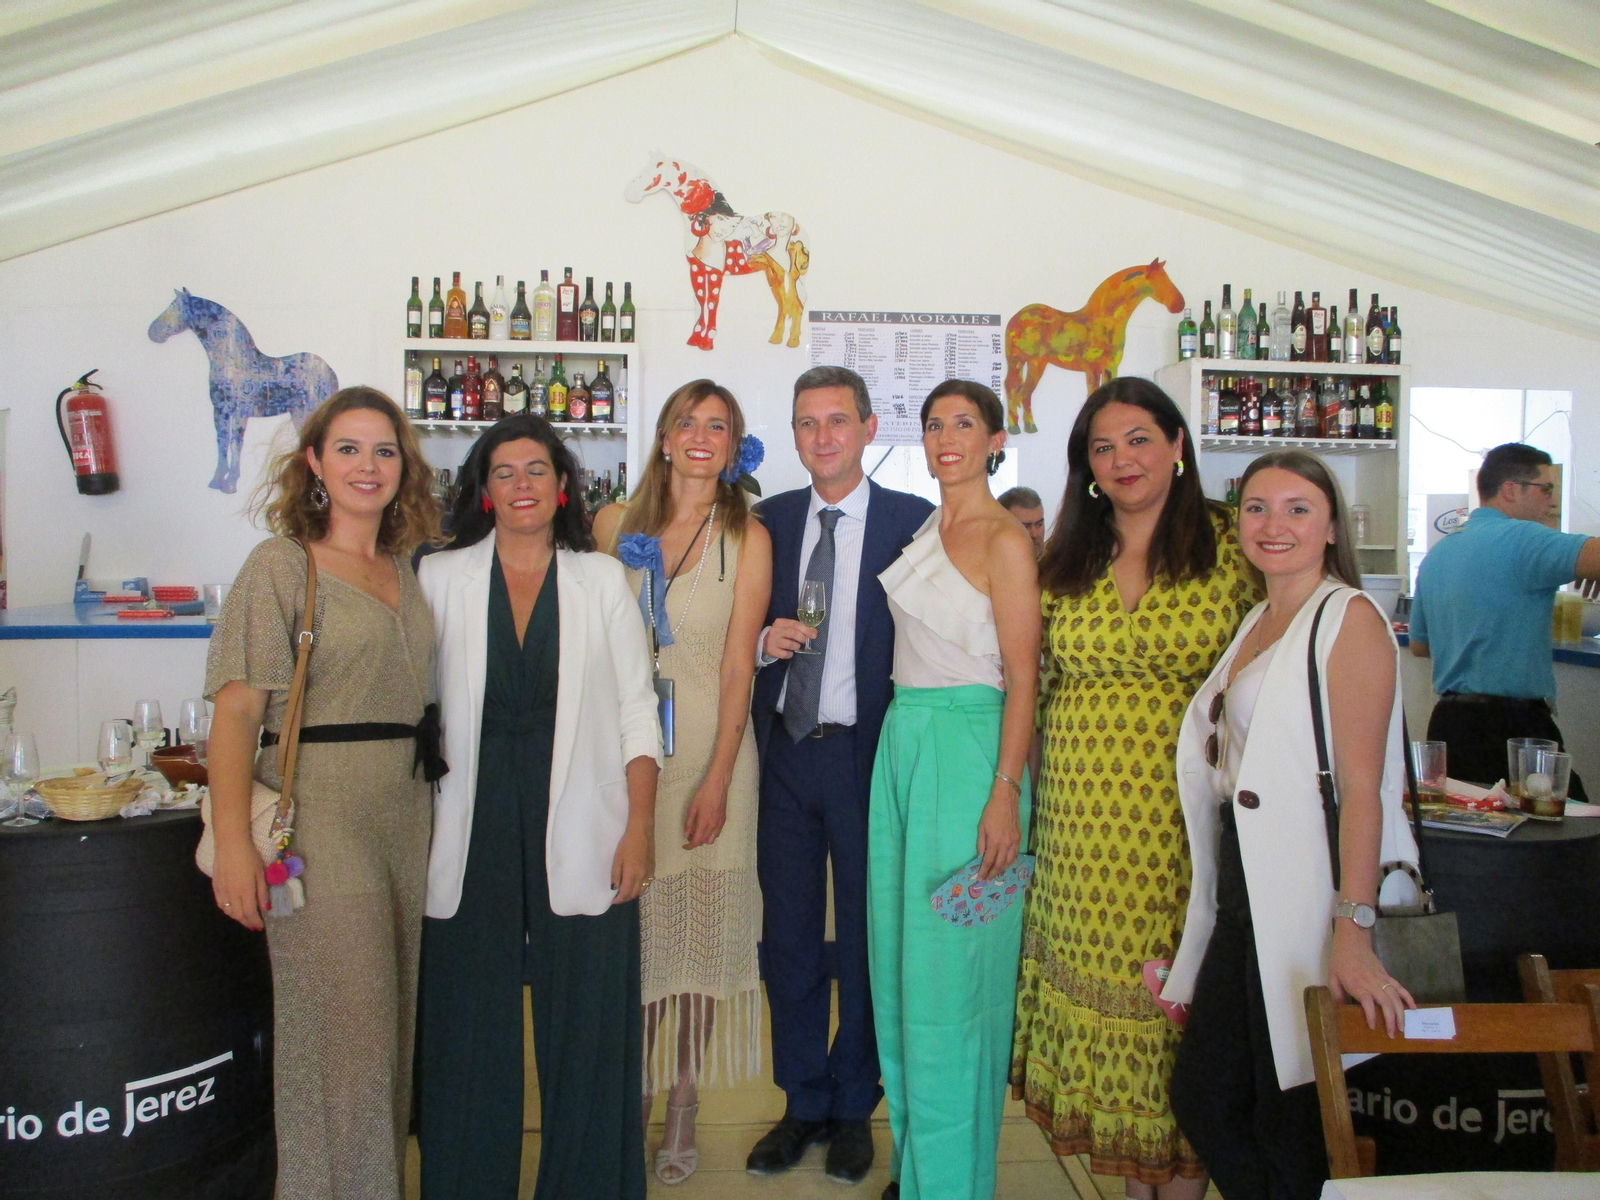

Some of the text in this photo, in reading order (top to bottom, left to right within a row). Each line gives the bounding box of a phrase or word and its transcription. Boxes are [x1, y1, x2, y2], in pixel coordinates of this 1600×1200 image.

[821, 312, 990, 325] RAFAEL MORALES
[57, 1101, 110, 1138] de
[122, 1075, 216, 1137] Jerez
[1348, 1087, 1554, 1144] ario de Jer
